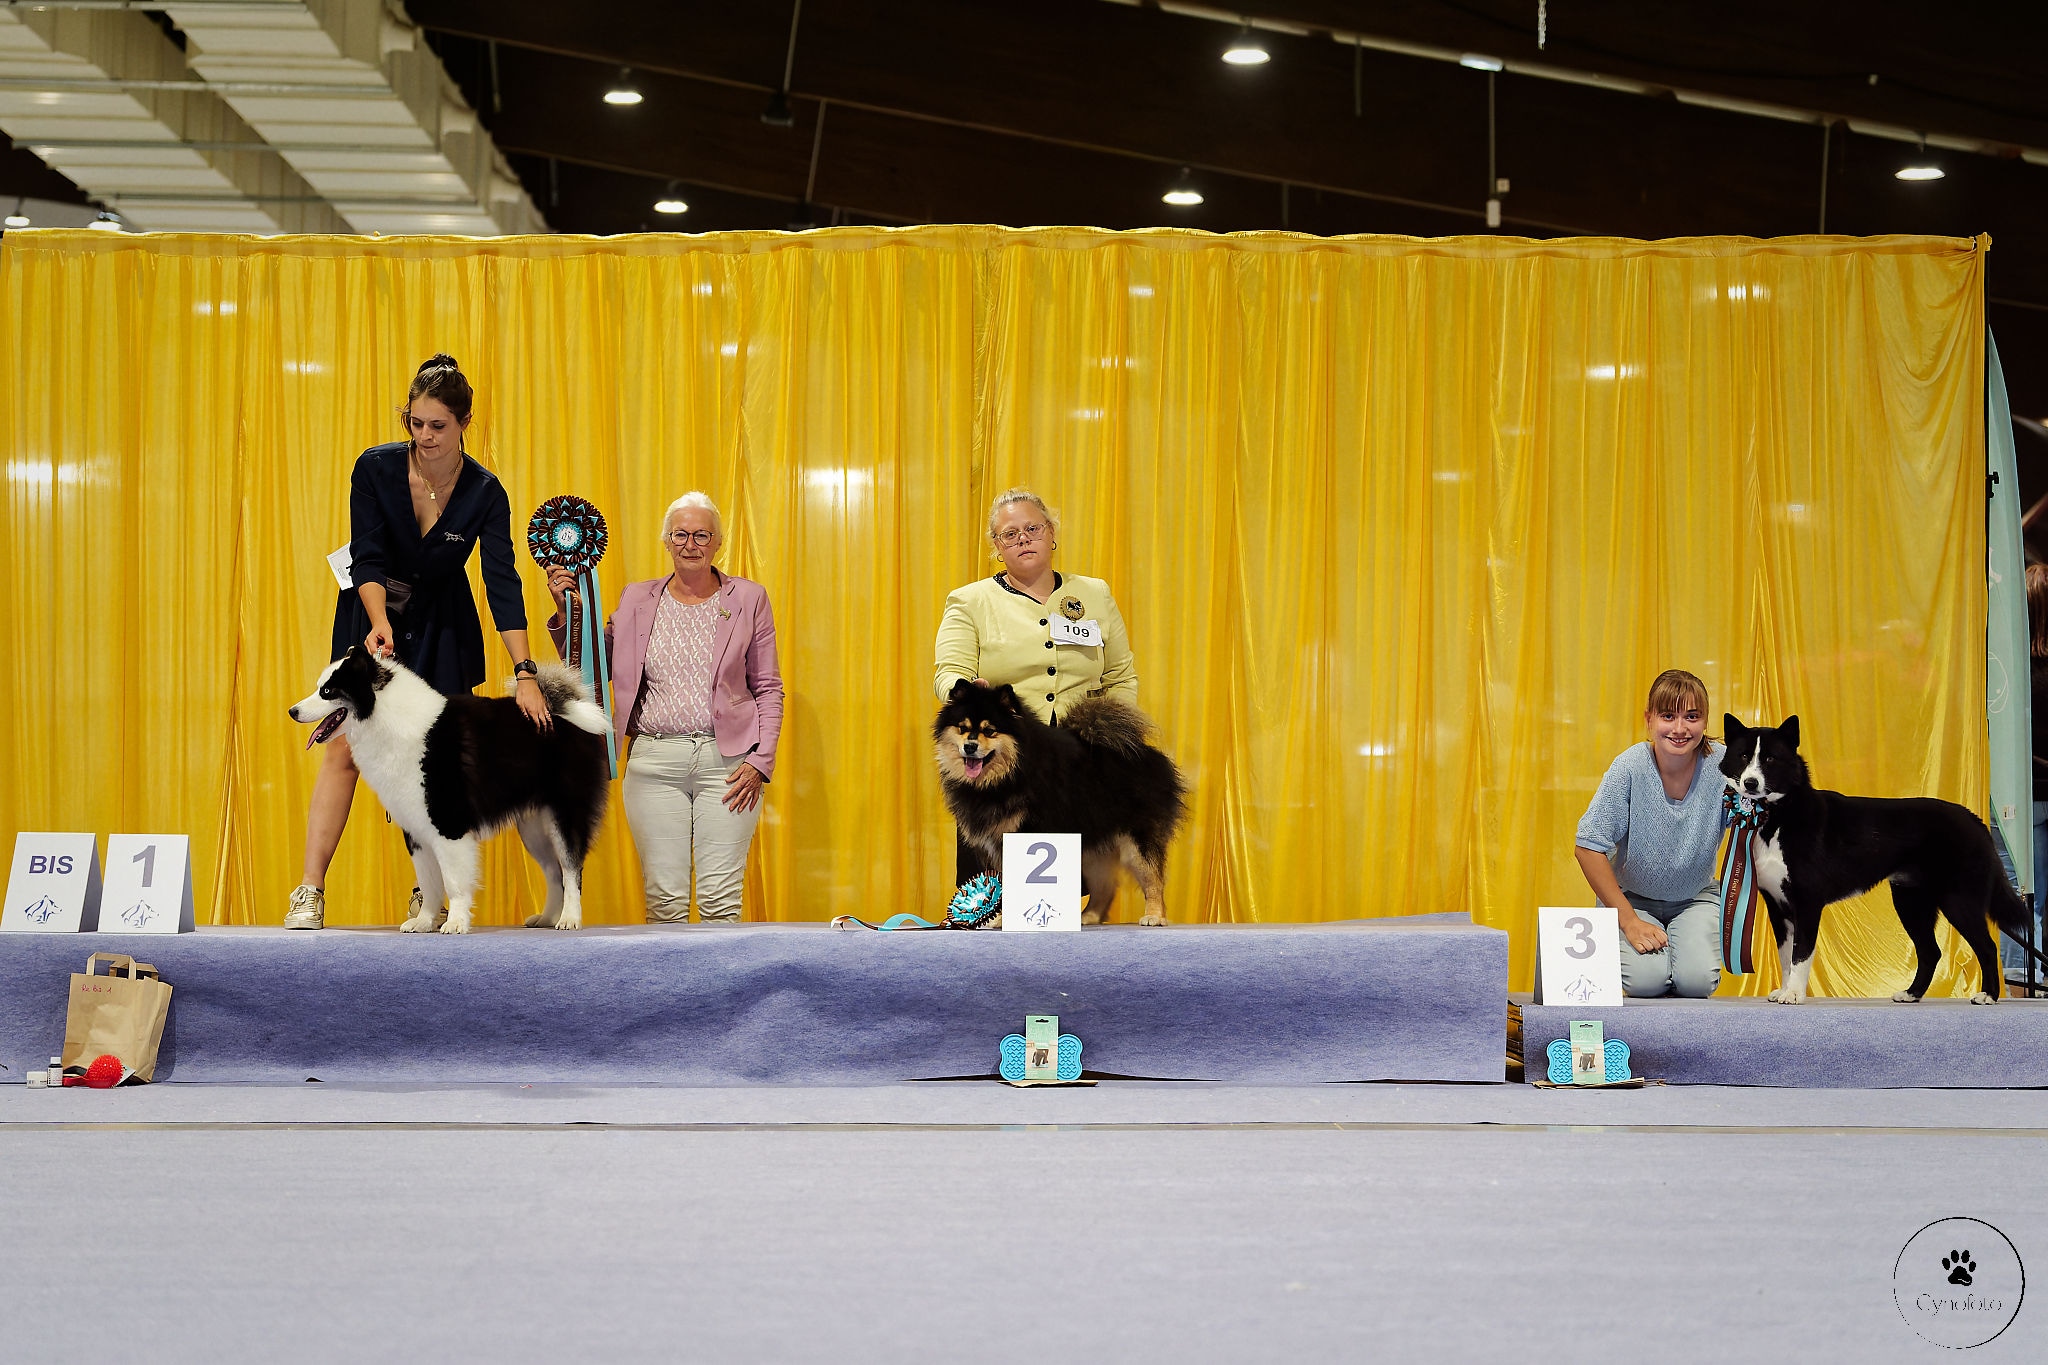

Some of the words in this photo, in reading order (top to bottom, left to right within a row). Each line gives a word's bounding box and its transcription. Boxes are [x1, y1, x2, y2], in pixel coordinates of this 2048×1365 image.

[572, 621, 580, 644] Show
[1064, 625, 1090, 638] 109
[28, 855, 74, 875] BIS
[132, 845, 157, 888] 1
[1025, 841, 1057, 884] 2
[1564, 917, 1597, 959] 3
